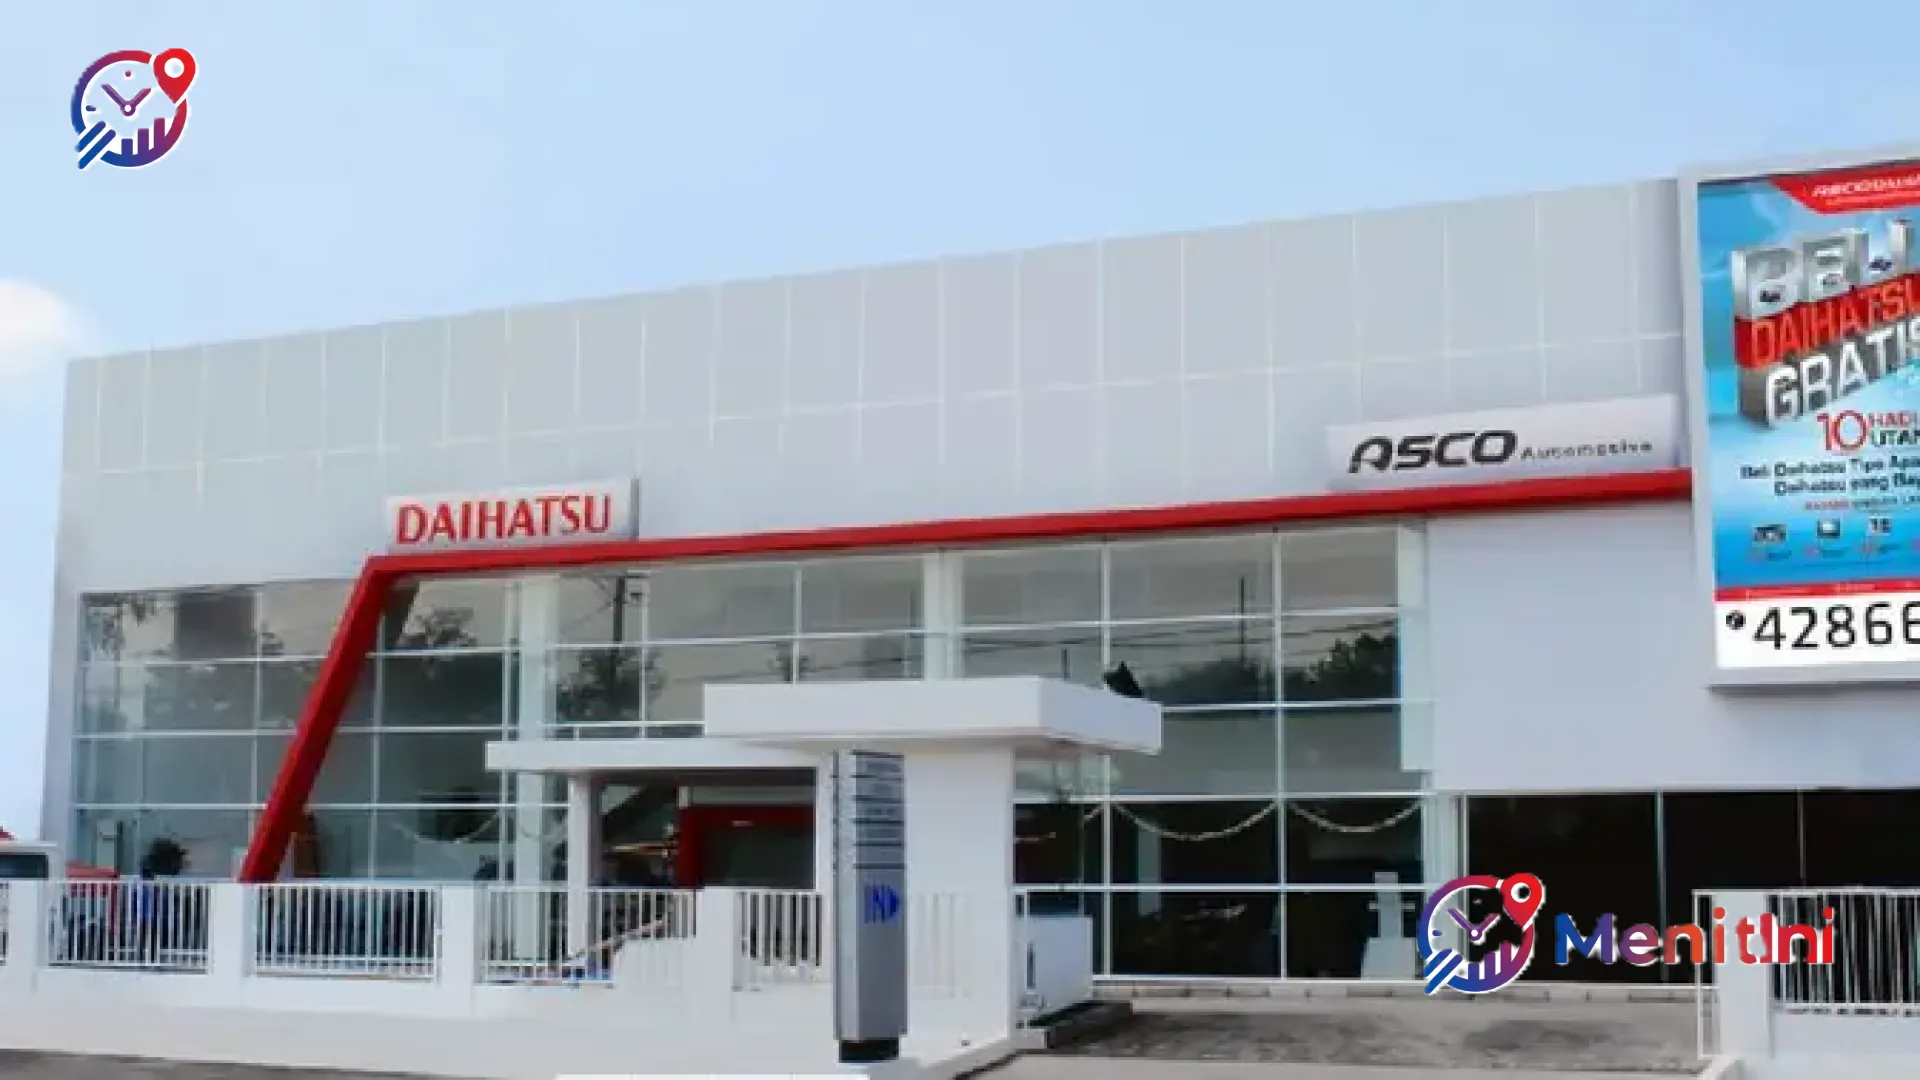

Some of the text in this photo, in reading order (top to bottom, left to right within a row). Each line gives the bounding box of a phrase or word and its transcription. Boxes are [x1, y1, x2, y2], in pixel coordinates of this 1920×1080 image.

[1731, 219, 1914, 321] BELI
[1347, 429, 1517, 474] ASCO
[1816, 410, 1868, 451] 10
[396, 492, 612, 546] DAIHATSU
